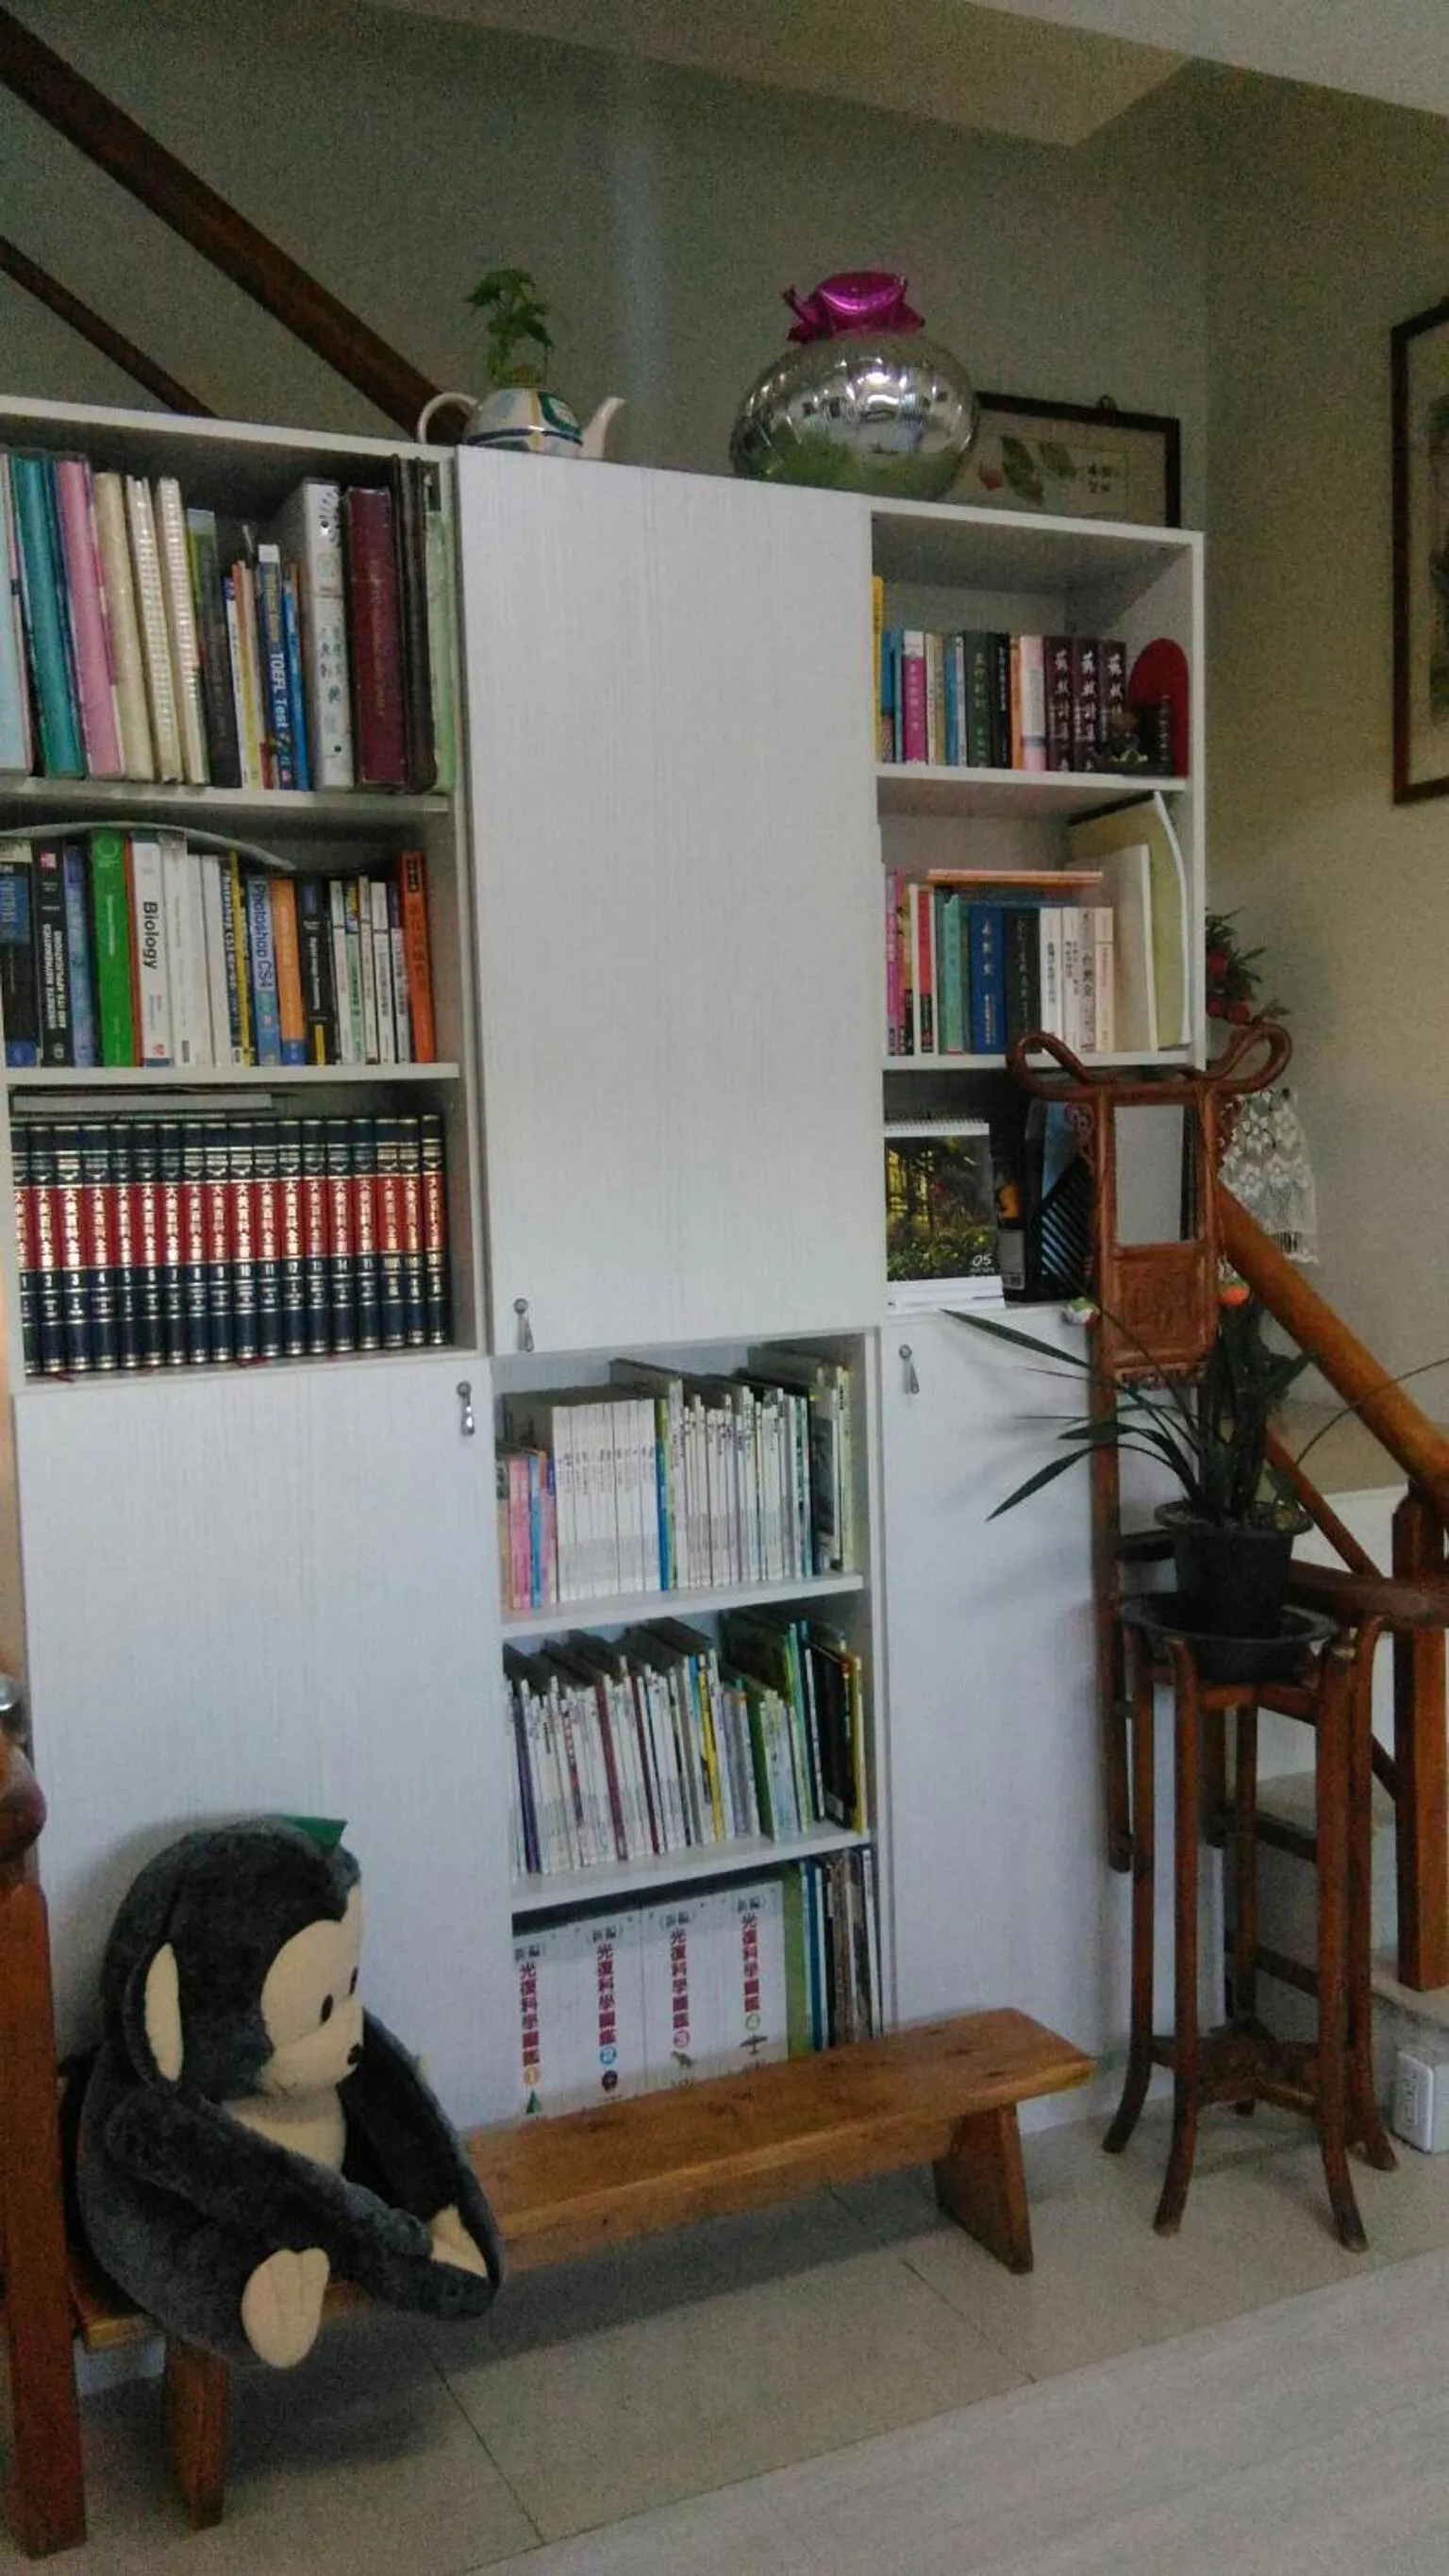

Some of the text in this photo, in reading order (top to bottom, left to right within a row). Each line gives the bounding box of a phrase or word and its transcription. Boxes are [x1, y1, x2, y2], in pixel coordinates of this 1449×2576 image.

[270, 653, 286, 694] TOEFL
[274, 697, 289, 728] Test
[142, 901, 158, 969] Biology
[253, 884, 274, 988] Photoshop CS4
